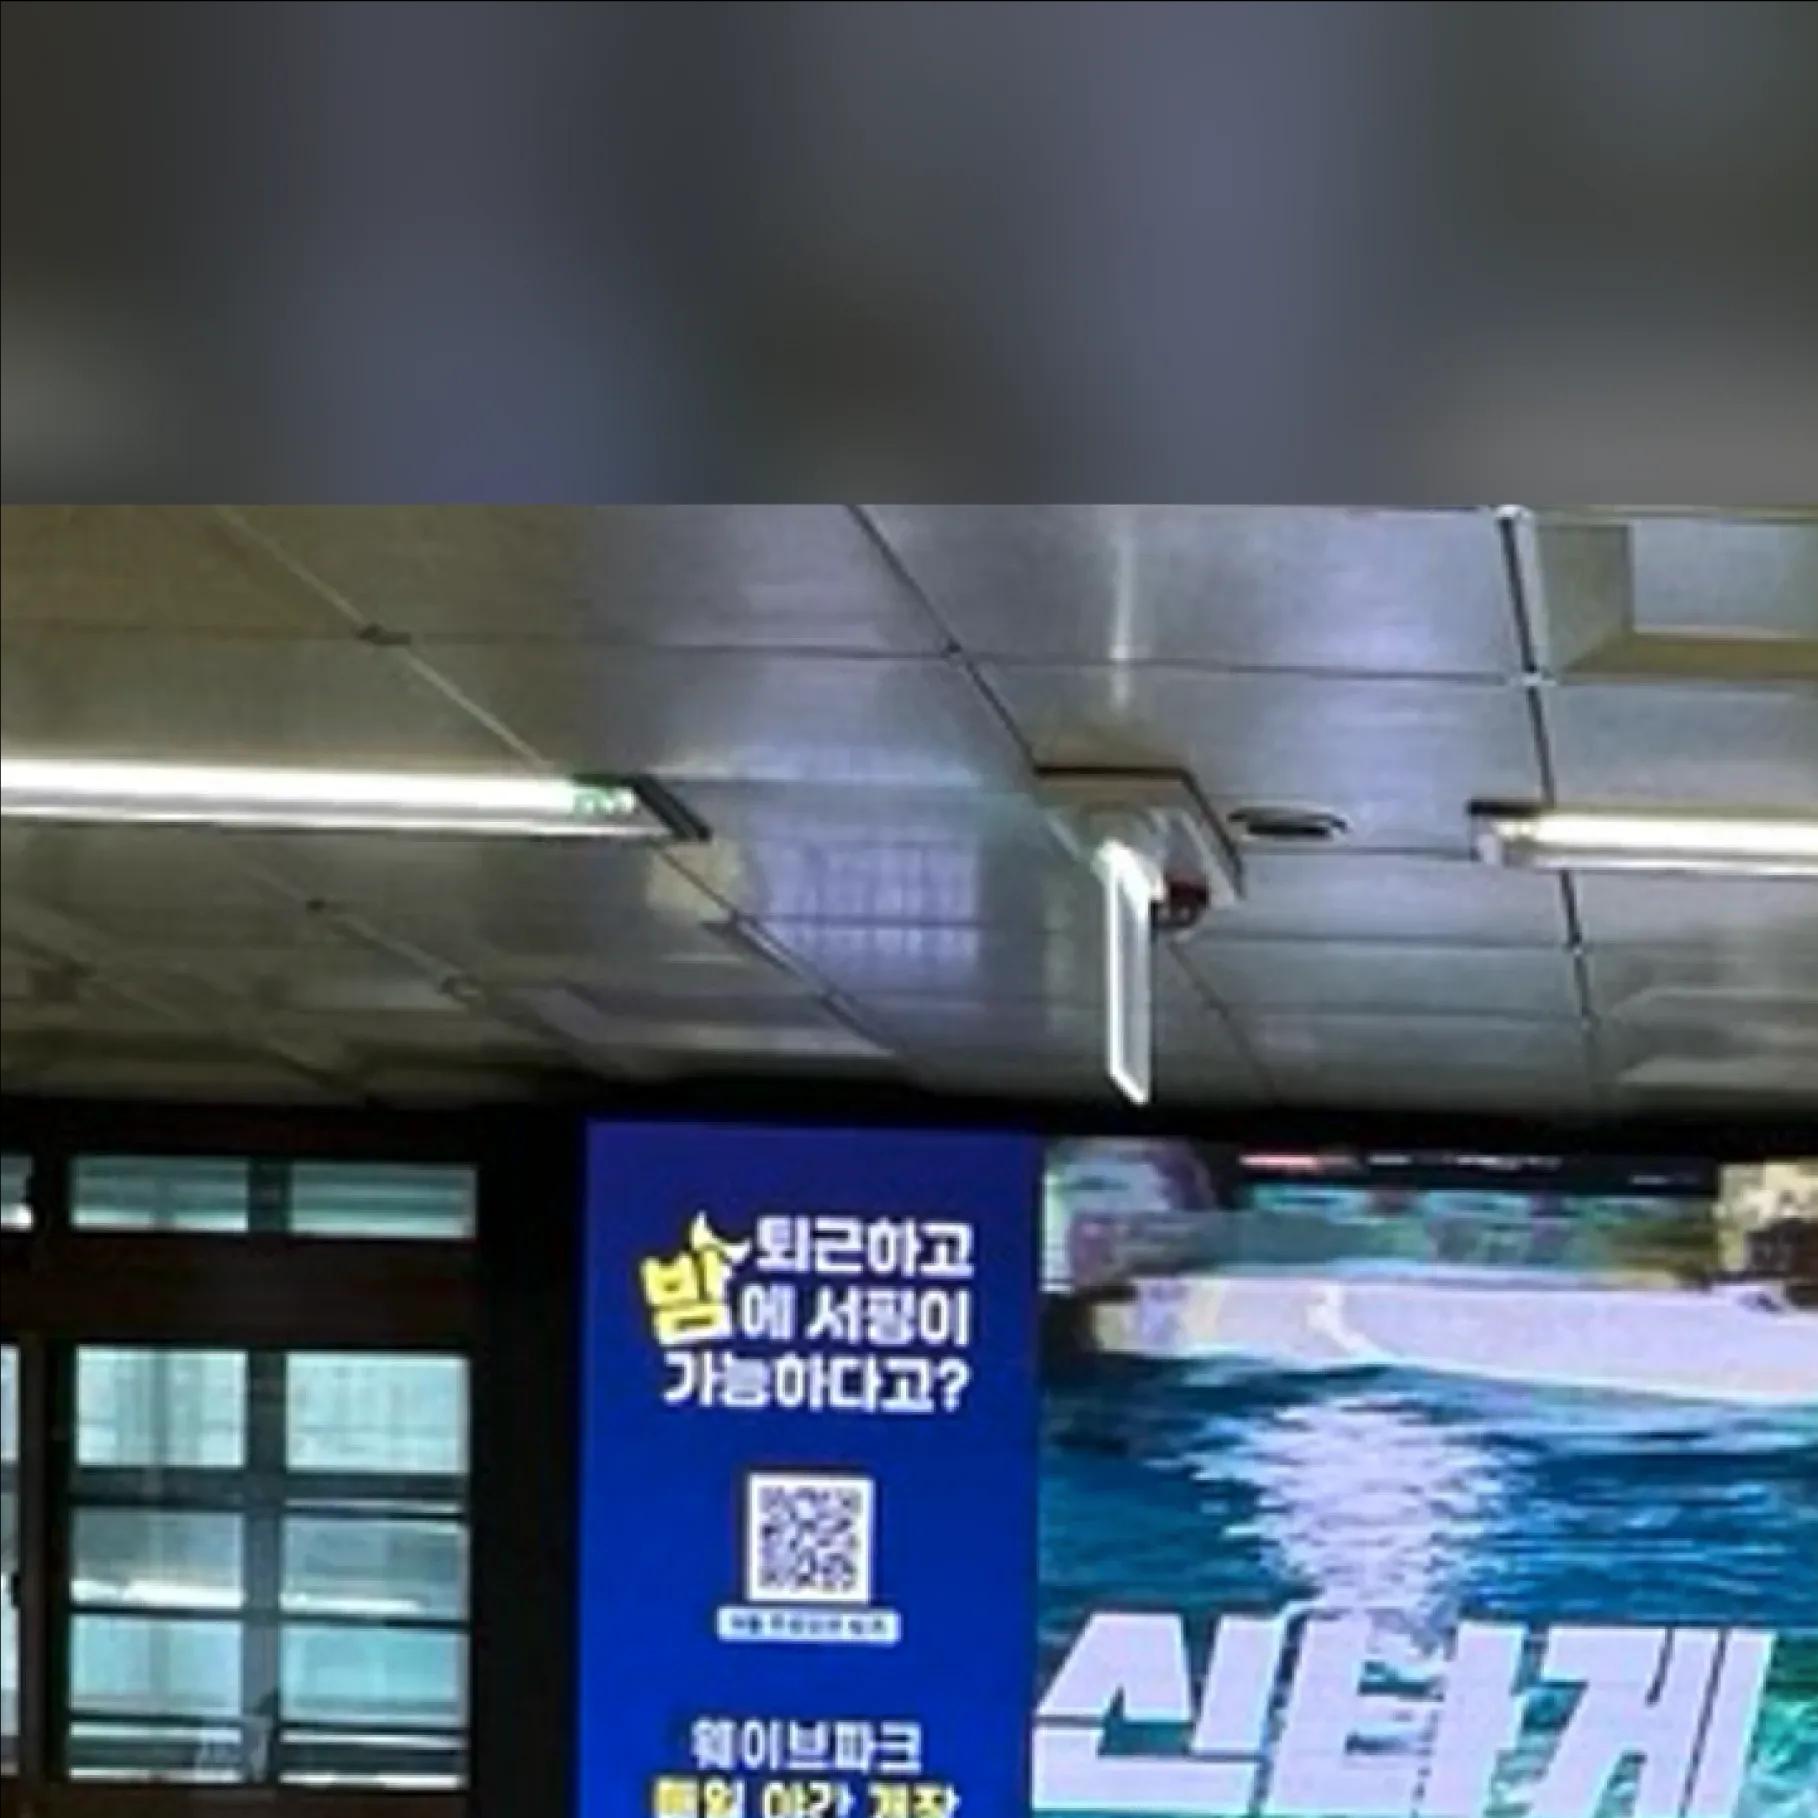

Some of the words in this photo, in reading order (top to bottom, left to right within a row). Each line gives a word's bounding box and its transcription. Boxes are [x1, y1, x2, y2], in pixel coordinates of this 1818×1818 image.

[755, 1215, 975, 1278] 퇴근하고
[805, 1284, 970, 1347] 서핑이
[663, 1351, 972, 1414] 가능하다고?
